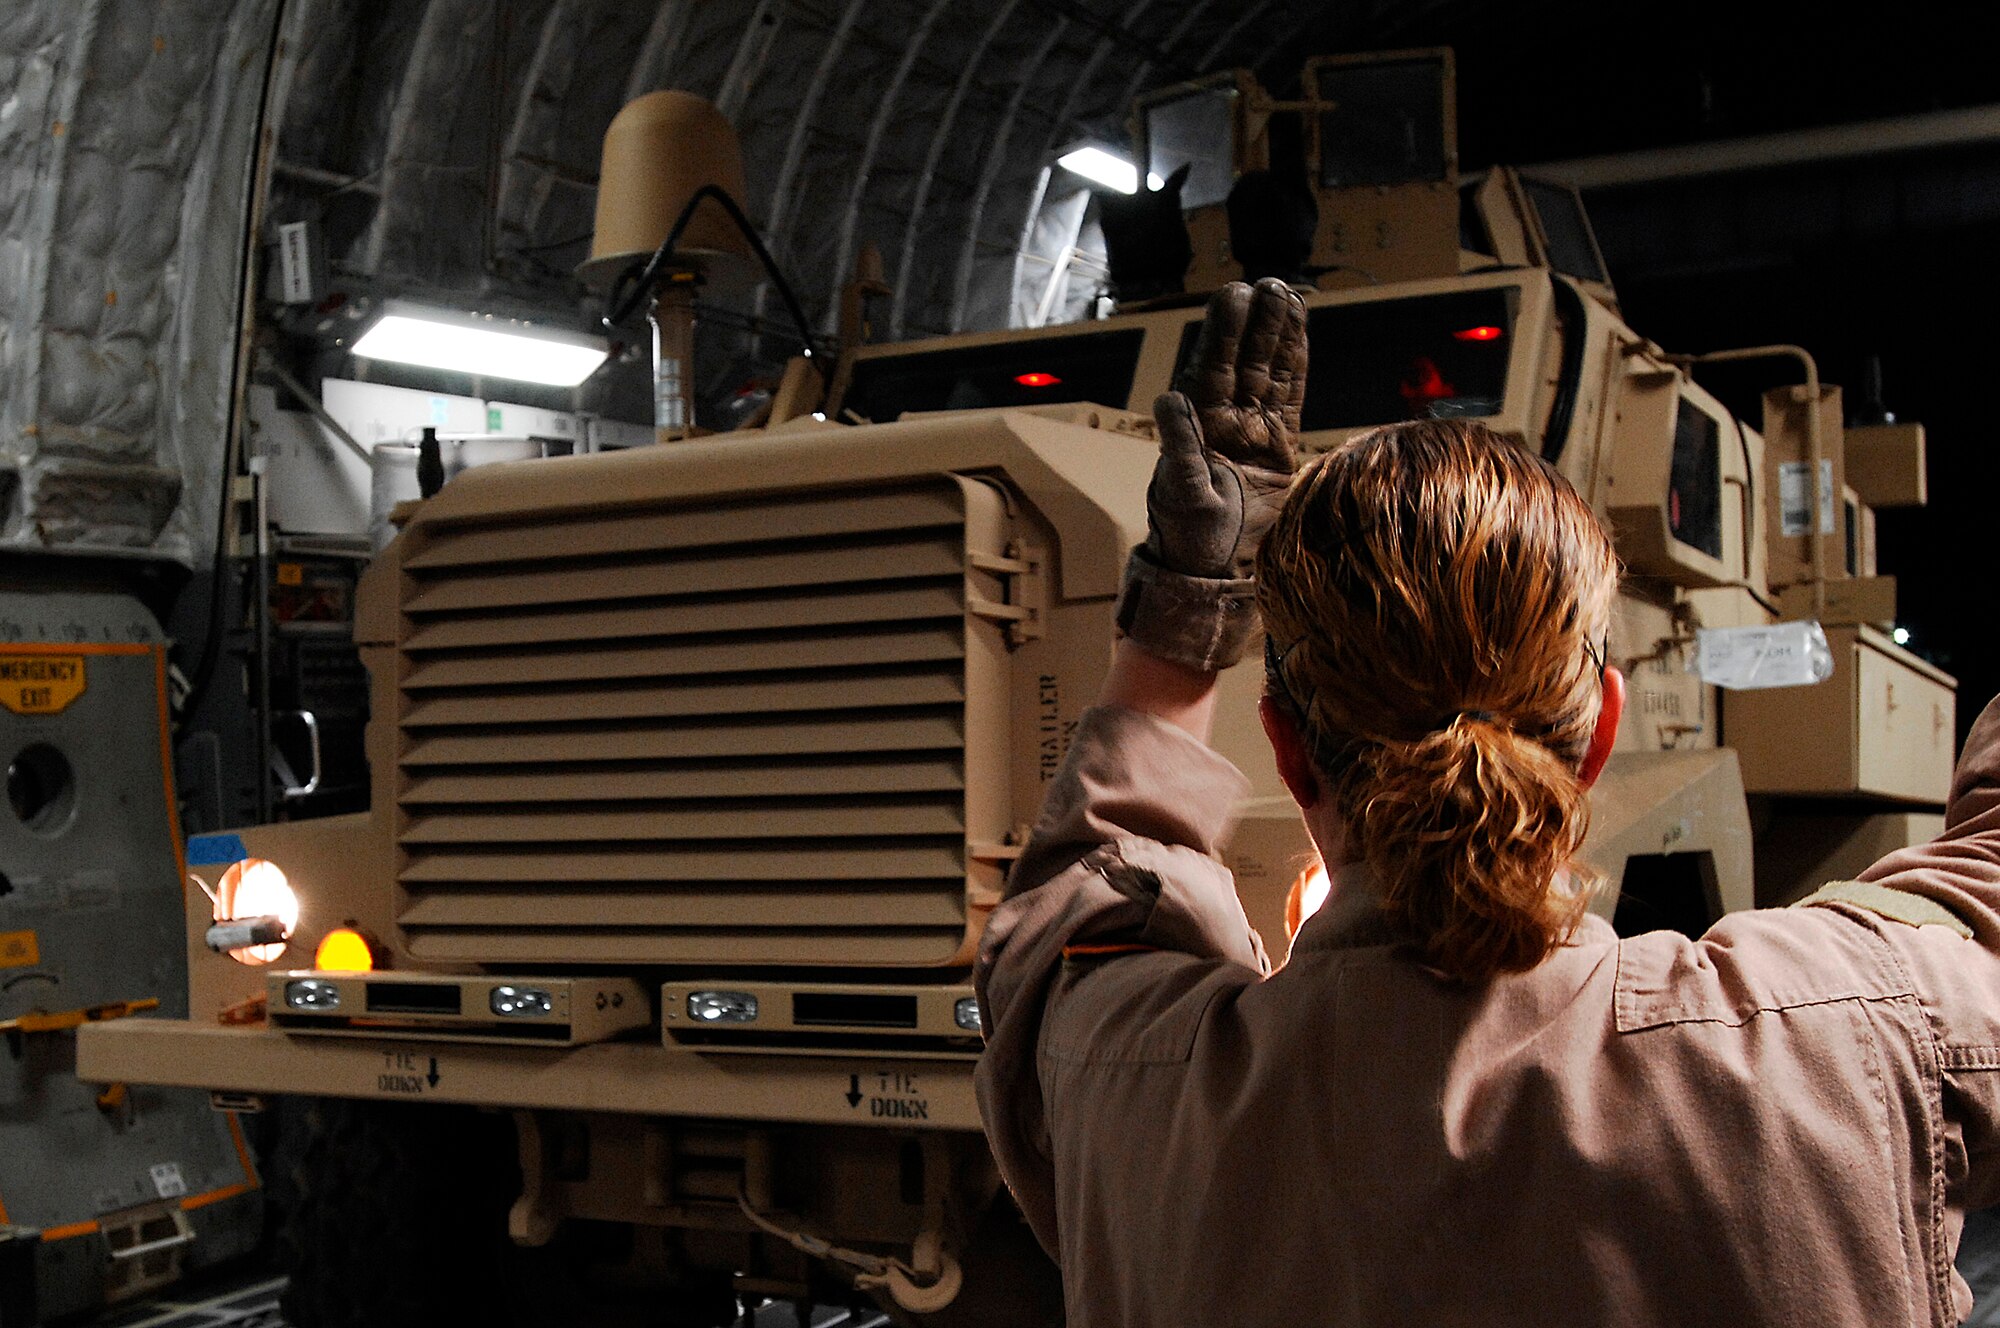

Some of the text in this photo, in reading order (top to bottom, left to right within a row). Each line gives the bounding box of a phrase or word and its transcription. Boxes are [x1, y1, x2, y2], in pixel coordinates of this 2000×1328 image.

[20, 687, 51, 708] EXIT
[1039, 674, 1058, 782] TRAILER
[382, 1050, 417, 1071] TIE
[877, 1071, 918, 1094] TIE
